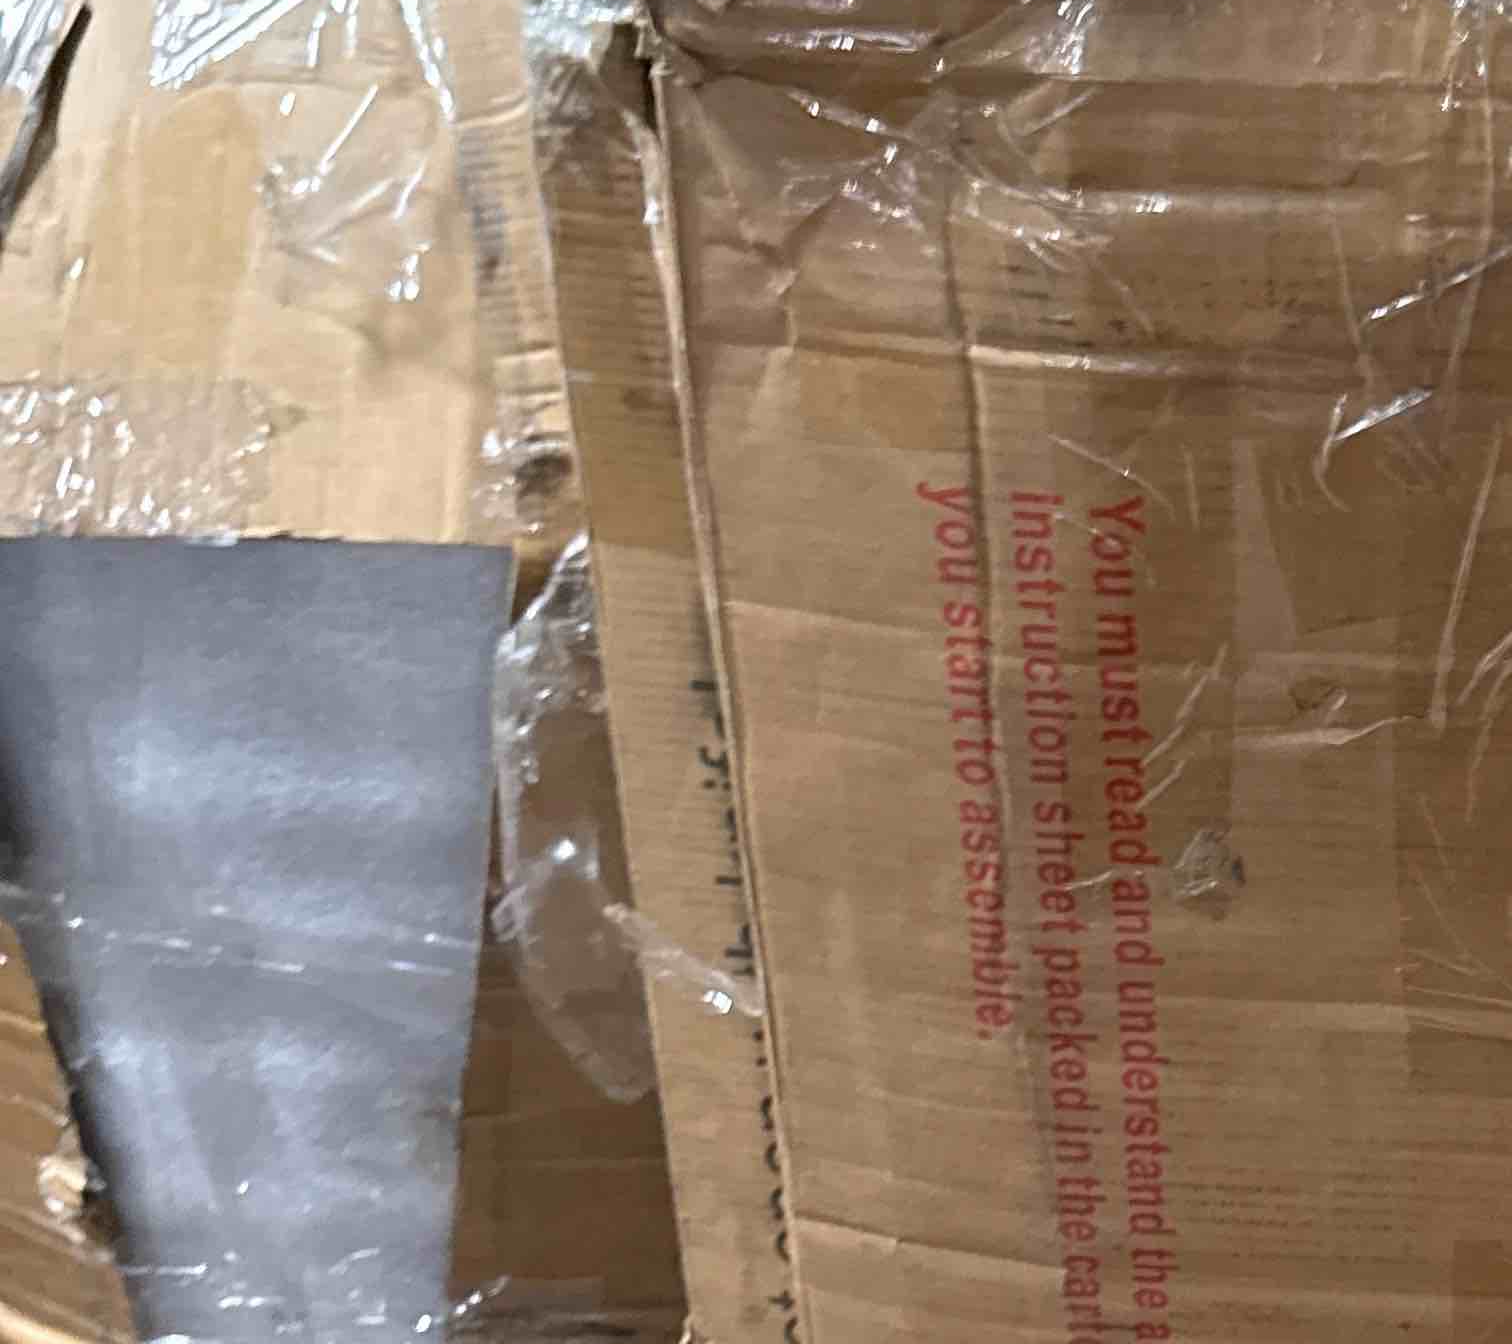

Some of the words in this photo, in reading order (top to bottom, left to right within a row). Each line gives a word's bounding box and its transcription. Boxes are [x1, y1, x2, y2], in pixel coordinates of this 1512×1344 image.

[916, 481, 979, 585] you
[1087, 497, 1148, 598] You
[944, 602, 999, 725] start
[1011, 490, 1078, 784] instruction
[1097, 615, 1150, 745] must
[956, 738, 1006, 784] to
[1102, 756, 1163, 866] read
[956, 799, 1020, 1041] assemble.
[1032, 801, 1089, 935] sheet
[1111, 873, 1164, 967] and
[1030, 946, 1097, 1111] packed
[1056, 1123, 1103, 1164] in
[1116, 980, 1174, 1234] understand
[1061, 1177, 1104, 1241] the
[1128, 1247, 1179, 1309] the
